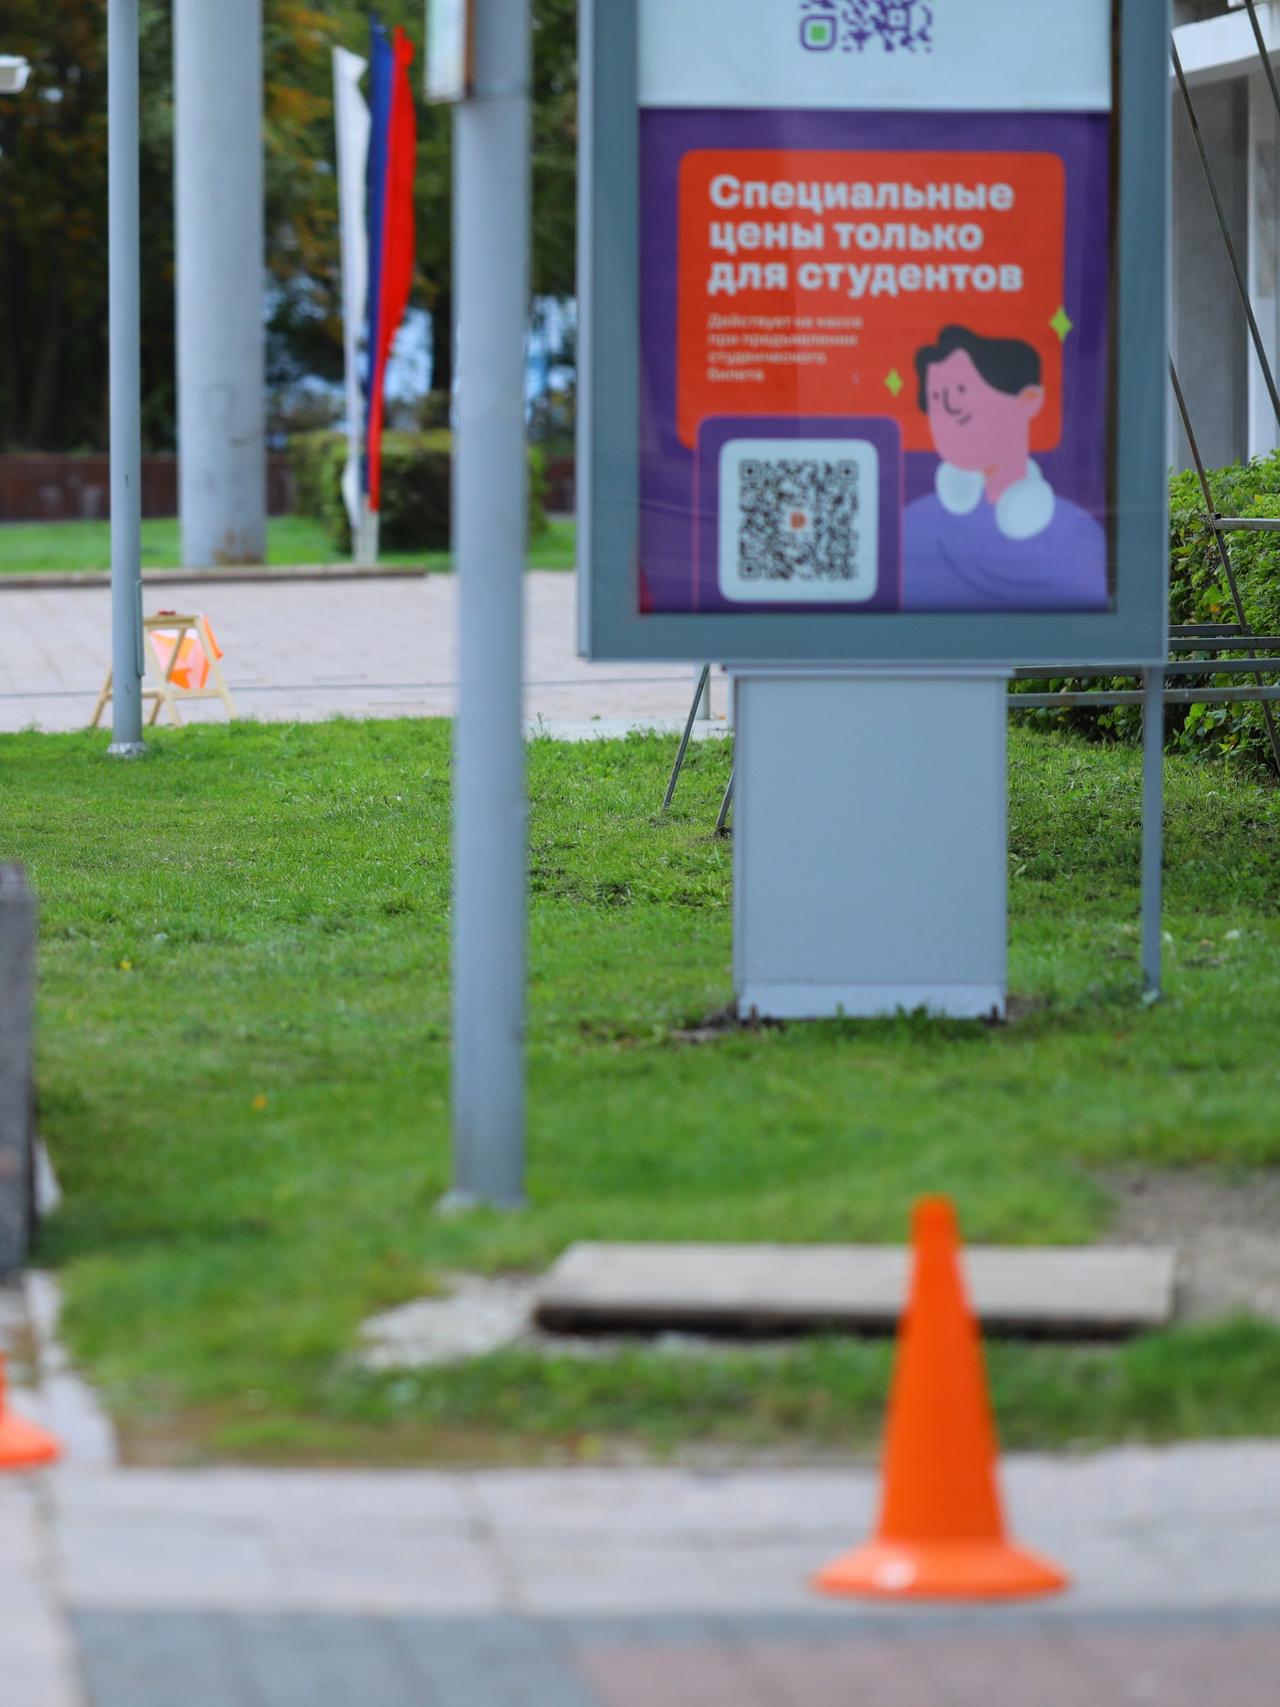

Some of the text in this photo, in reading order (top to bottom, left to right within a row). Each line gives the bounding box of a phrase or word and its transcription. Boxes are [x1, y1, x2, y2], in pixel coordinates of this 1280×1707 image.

[708, 174, 1015, 214] Специальные
[708, 221, 984, 255] цены только
[707, 261, 1024, 299] для студентов
